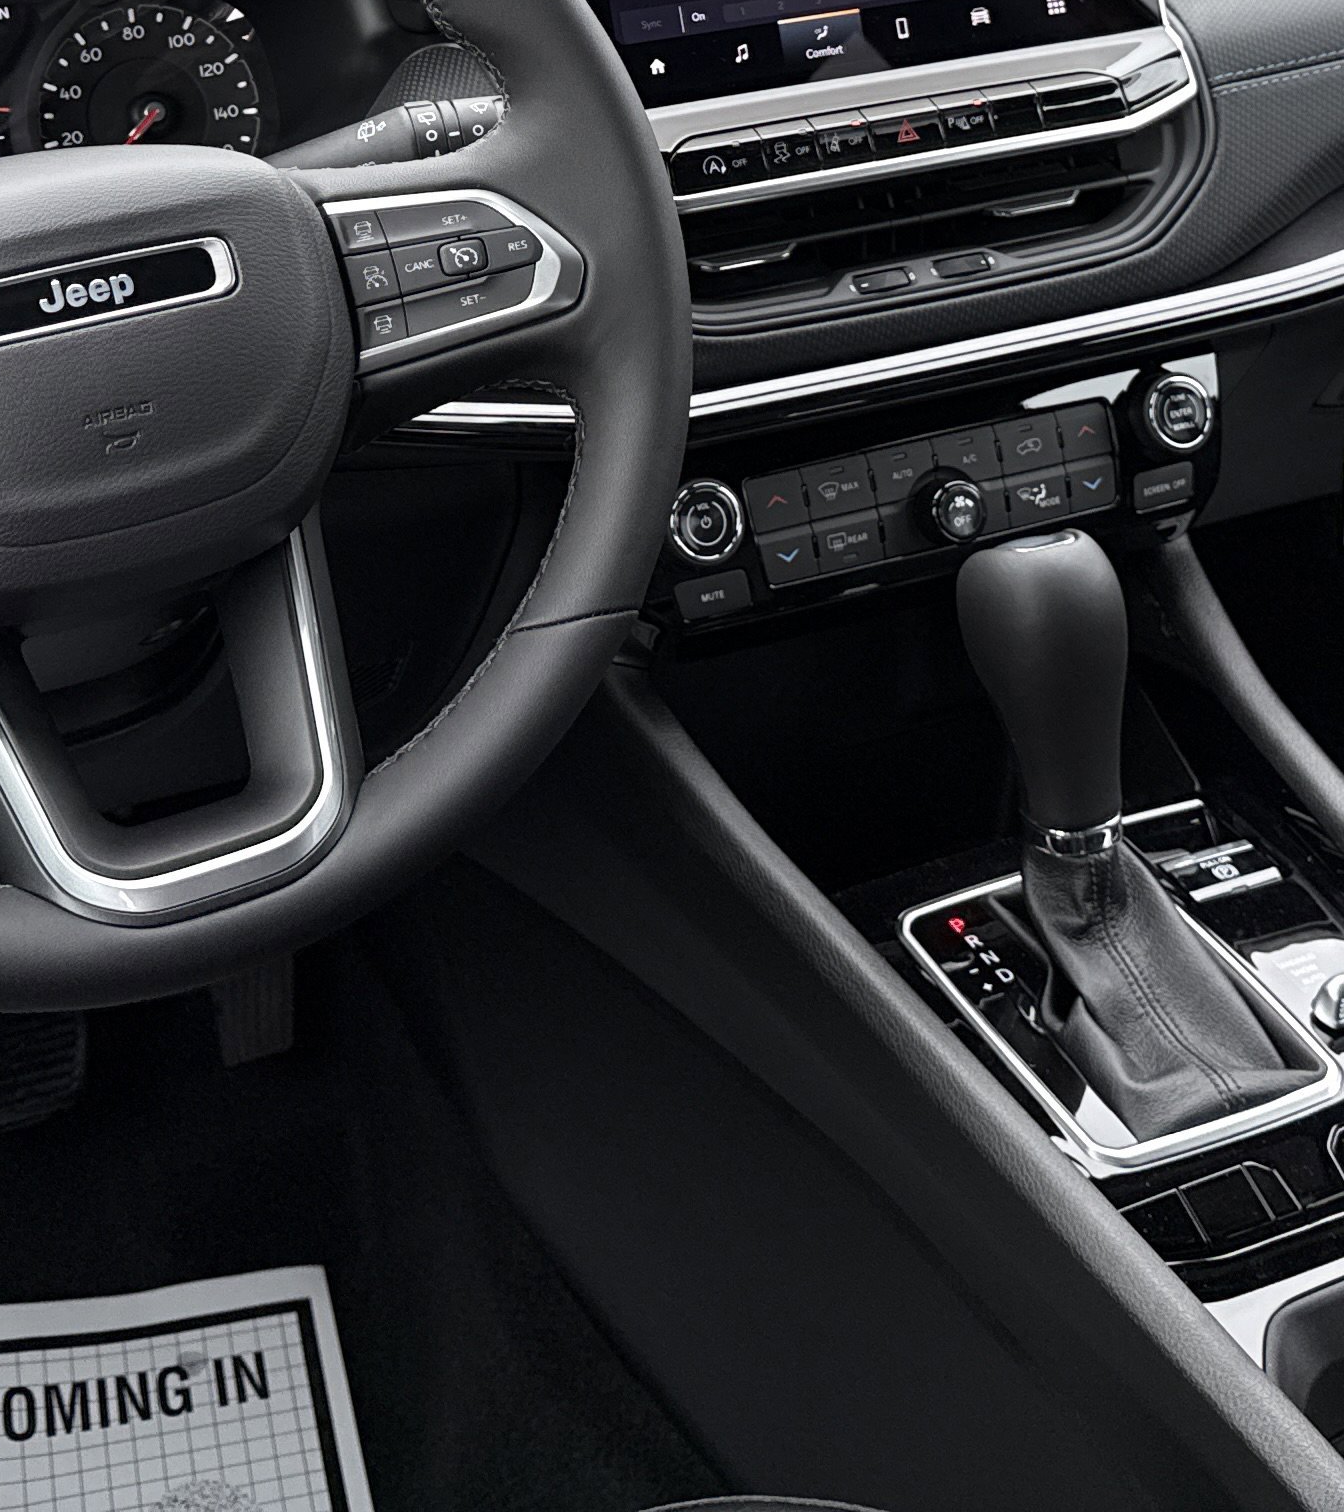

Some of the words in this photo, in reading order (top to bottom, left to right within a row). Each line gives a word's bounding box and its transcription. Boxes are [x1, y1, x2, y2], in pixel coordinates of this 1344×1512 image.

[691, 10, 707, 23] On
[122, 24, 146, 41] 80
[167, 31, 196, 48] 100
[79, 48, 103, 64] 60
[805, 44, 845, 61] Comfort
[199, 61, 225, 78] 120
[59, 84, 82, 101] 40
[213, 104, 240, 121] 140
[60, 129, 84, 147] 20
[507, 239, 529, 253] RES
[404, 258, 435, 273] CANC
[38, 273, 135, 314] Jeep
[81, 399, 154, 430] AIRBAG
[892, 468, 914, 481] AUTO
[840, 479, 860, 492] MAX
[1143, 482, 1171, 497] SCREEN
[1172, 477, 1187, 490] OFF
[1039, 495, 1061, 508] MODE
[953, 514, 973, 527] OFF
[846, 532, 869, 545] REAR
[700, 589, 725, 603] MUTE
[948, 918, 965, 933] P
[964, 934, 984, 949] R
[978, 949, 1001, 965] N
[995, 968, 1015, 983] D
[212, 1350, 271, 1409] IN
